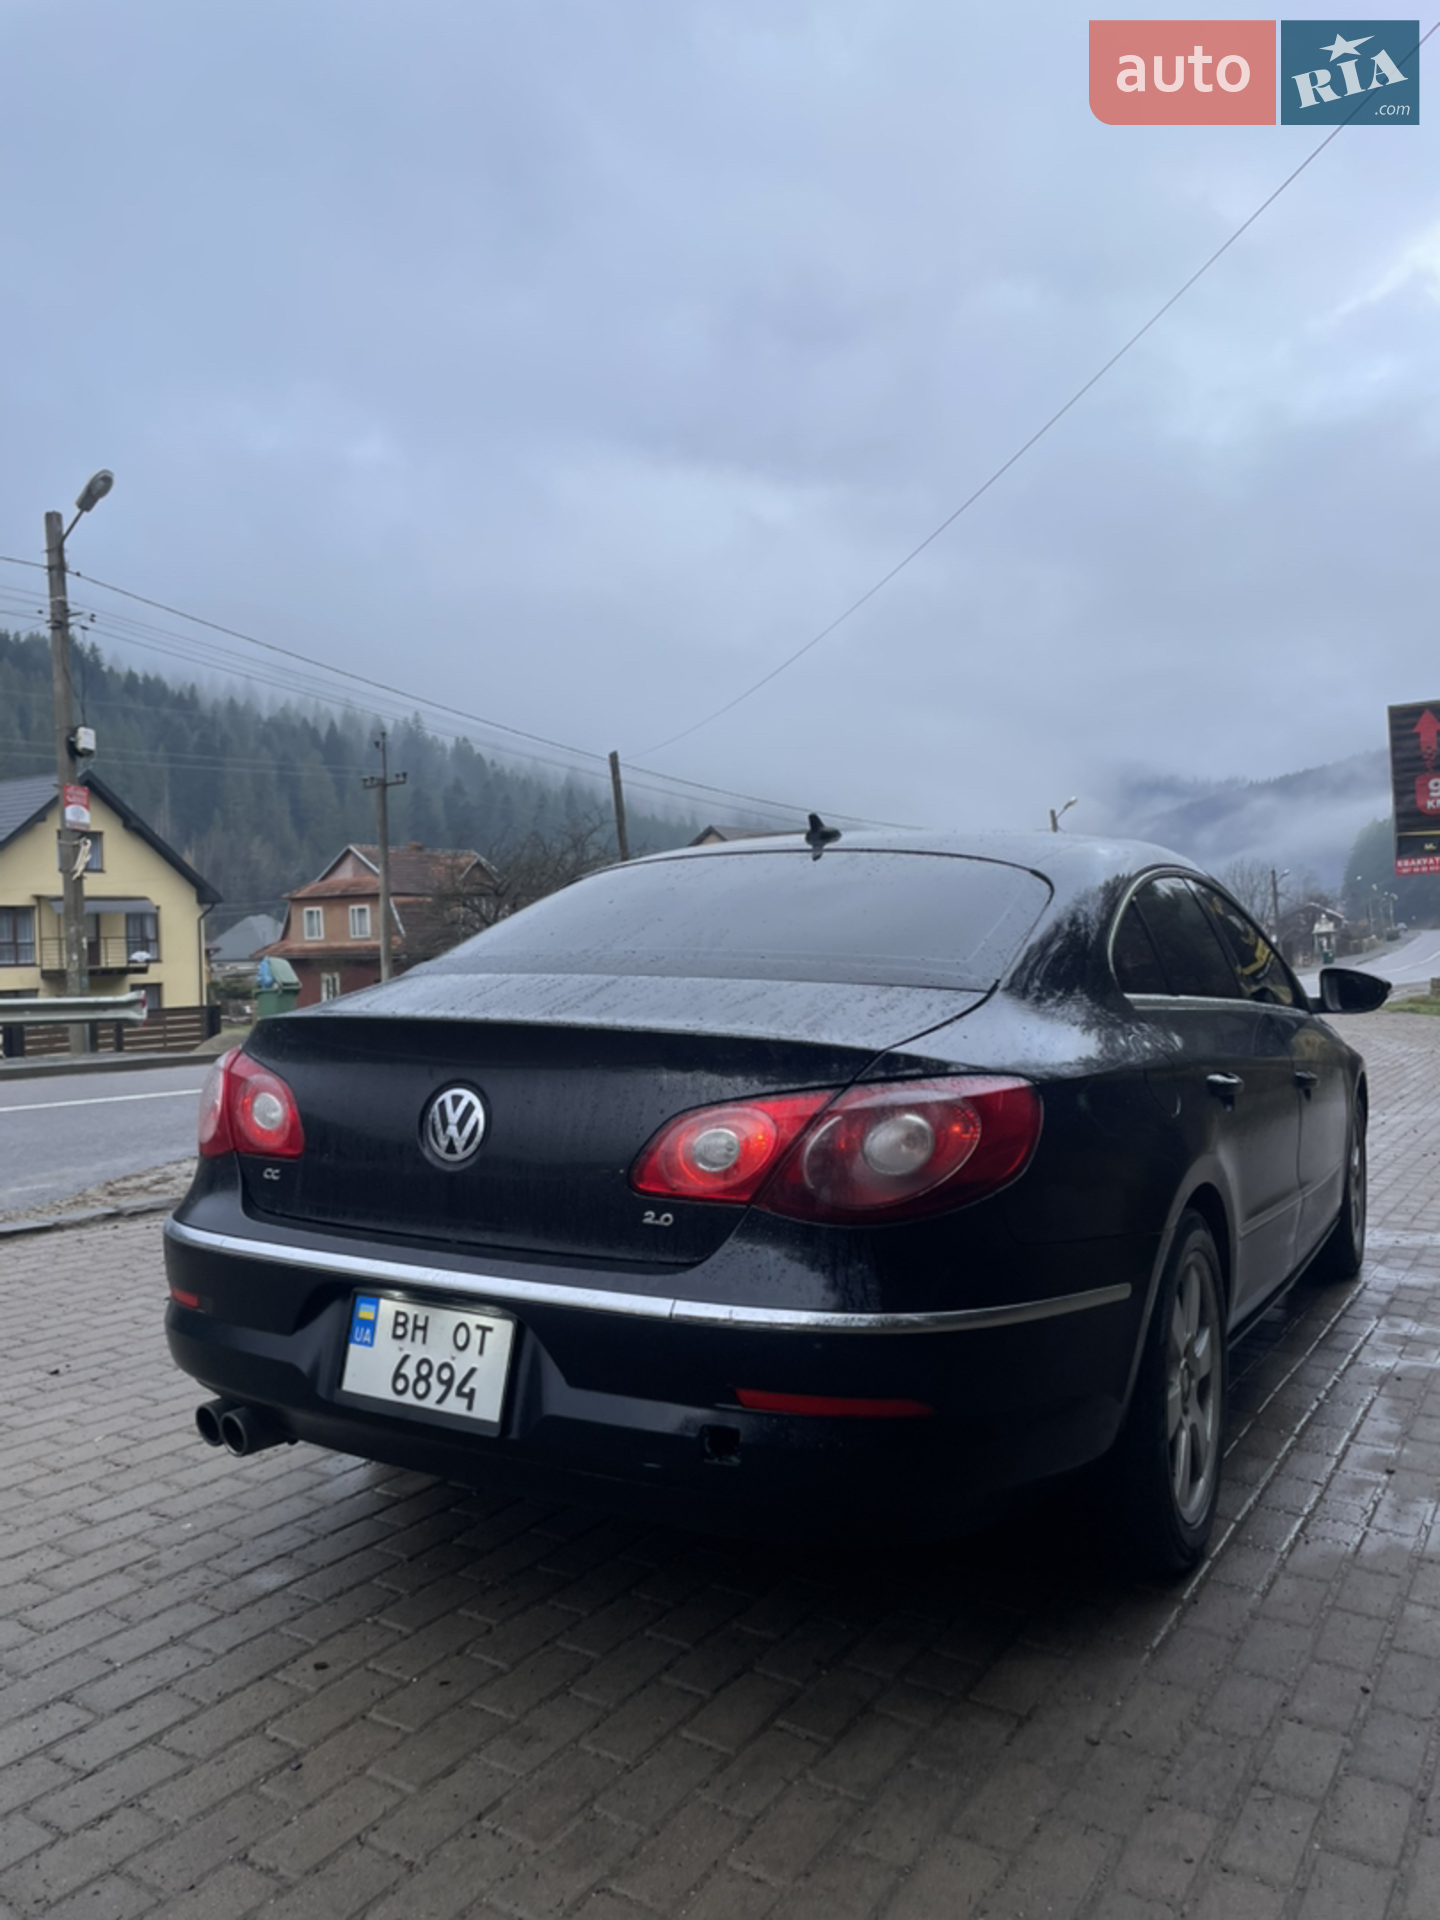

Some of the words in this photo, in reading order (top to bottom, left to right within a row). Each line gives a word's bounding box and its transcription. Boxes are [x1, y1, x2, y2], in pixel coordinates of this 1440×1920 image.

[642, 1210, 674, 1227] 2.0
[354, 1325, 373, 1345] UA
[391, 1310, 429, 1345] BH
[452, 1321, 494, 1356] OT
[391, 1354, 478, 1412] 6894
